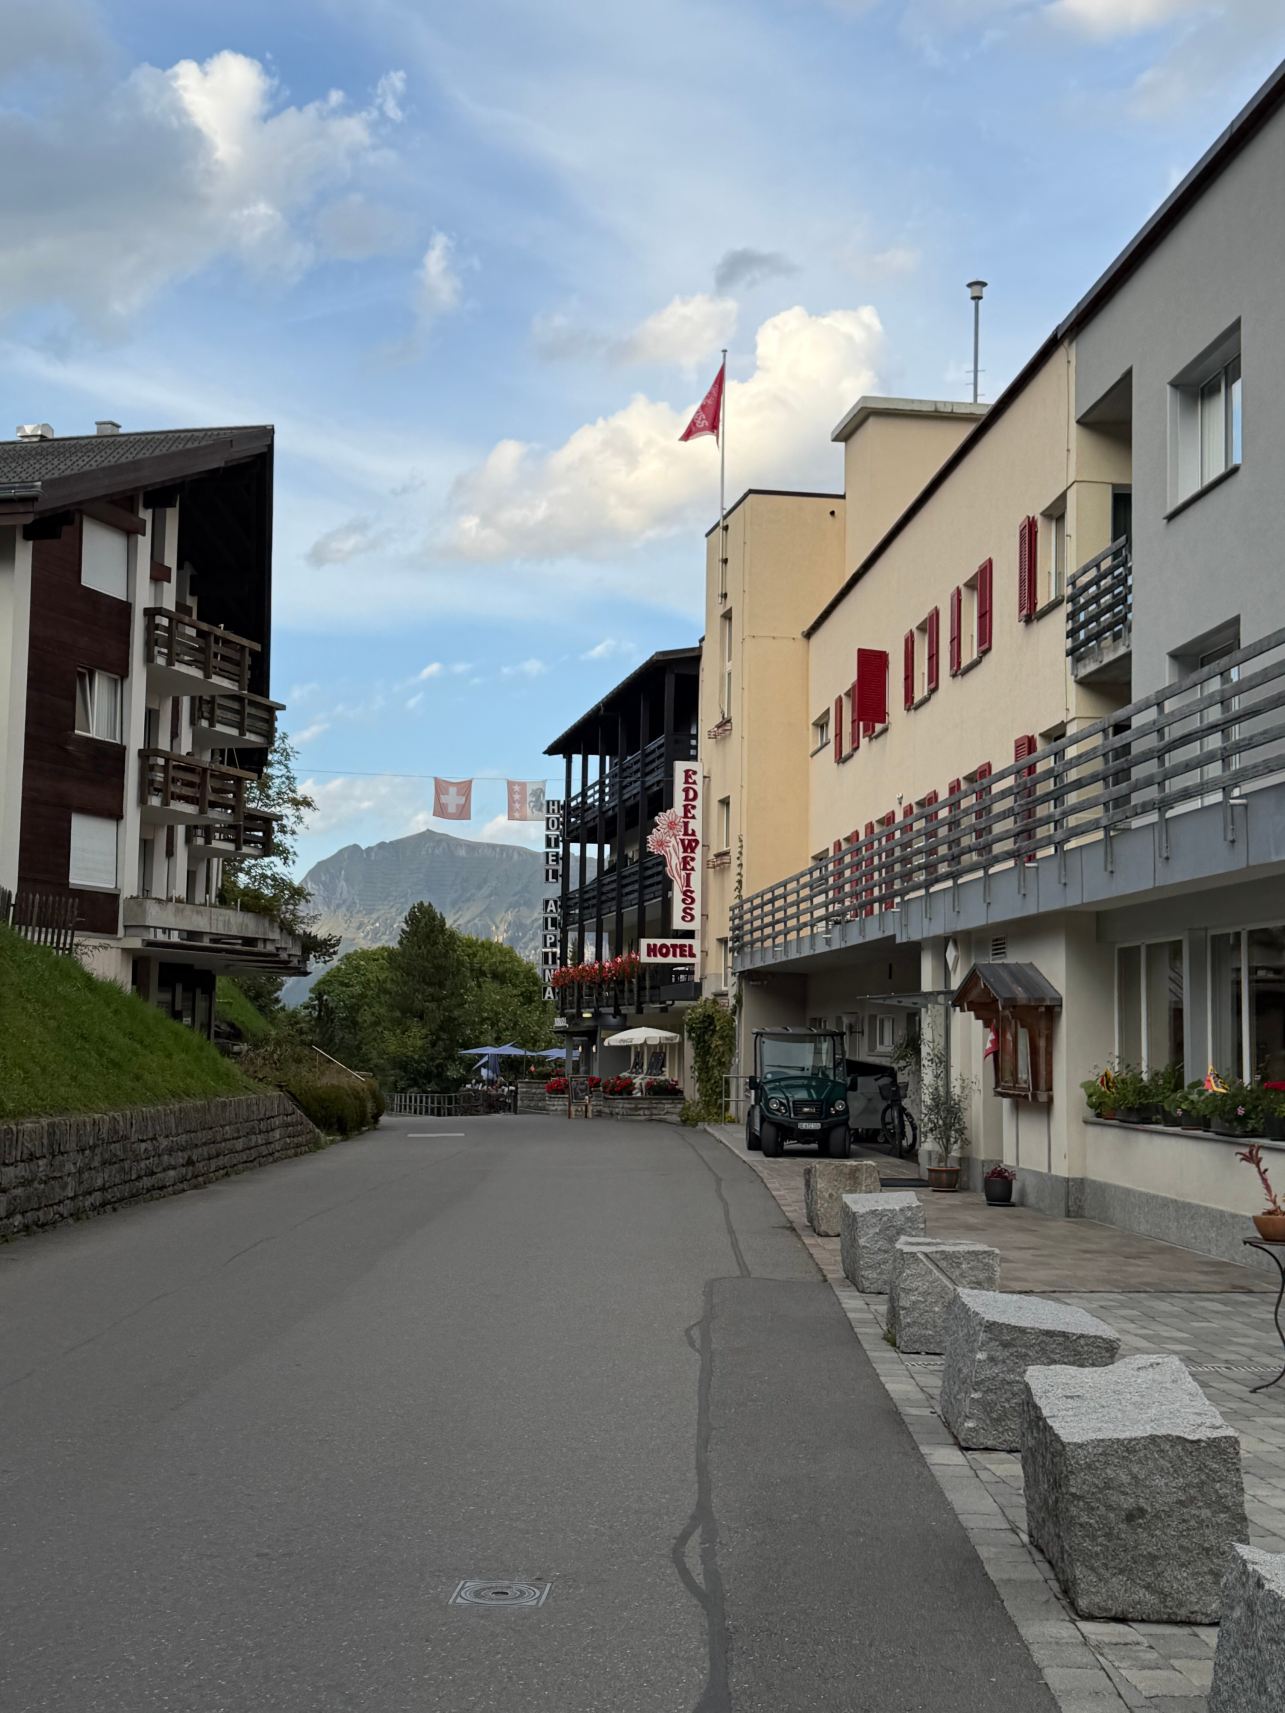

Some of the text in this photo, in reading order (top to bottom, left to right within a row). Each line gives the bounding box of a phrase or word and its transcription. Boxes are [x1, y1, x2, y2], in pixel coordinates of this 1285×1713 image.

[543, 801, 560, 1000] HOTEL ALPINA
[680, 769, 700, 923] EDELWEISS
[646, 942, 697, 958] HOTEL
